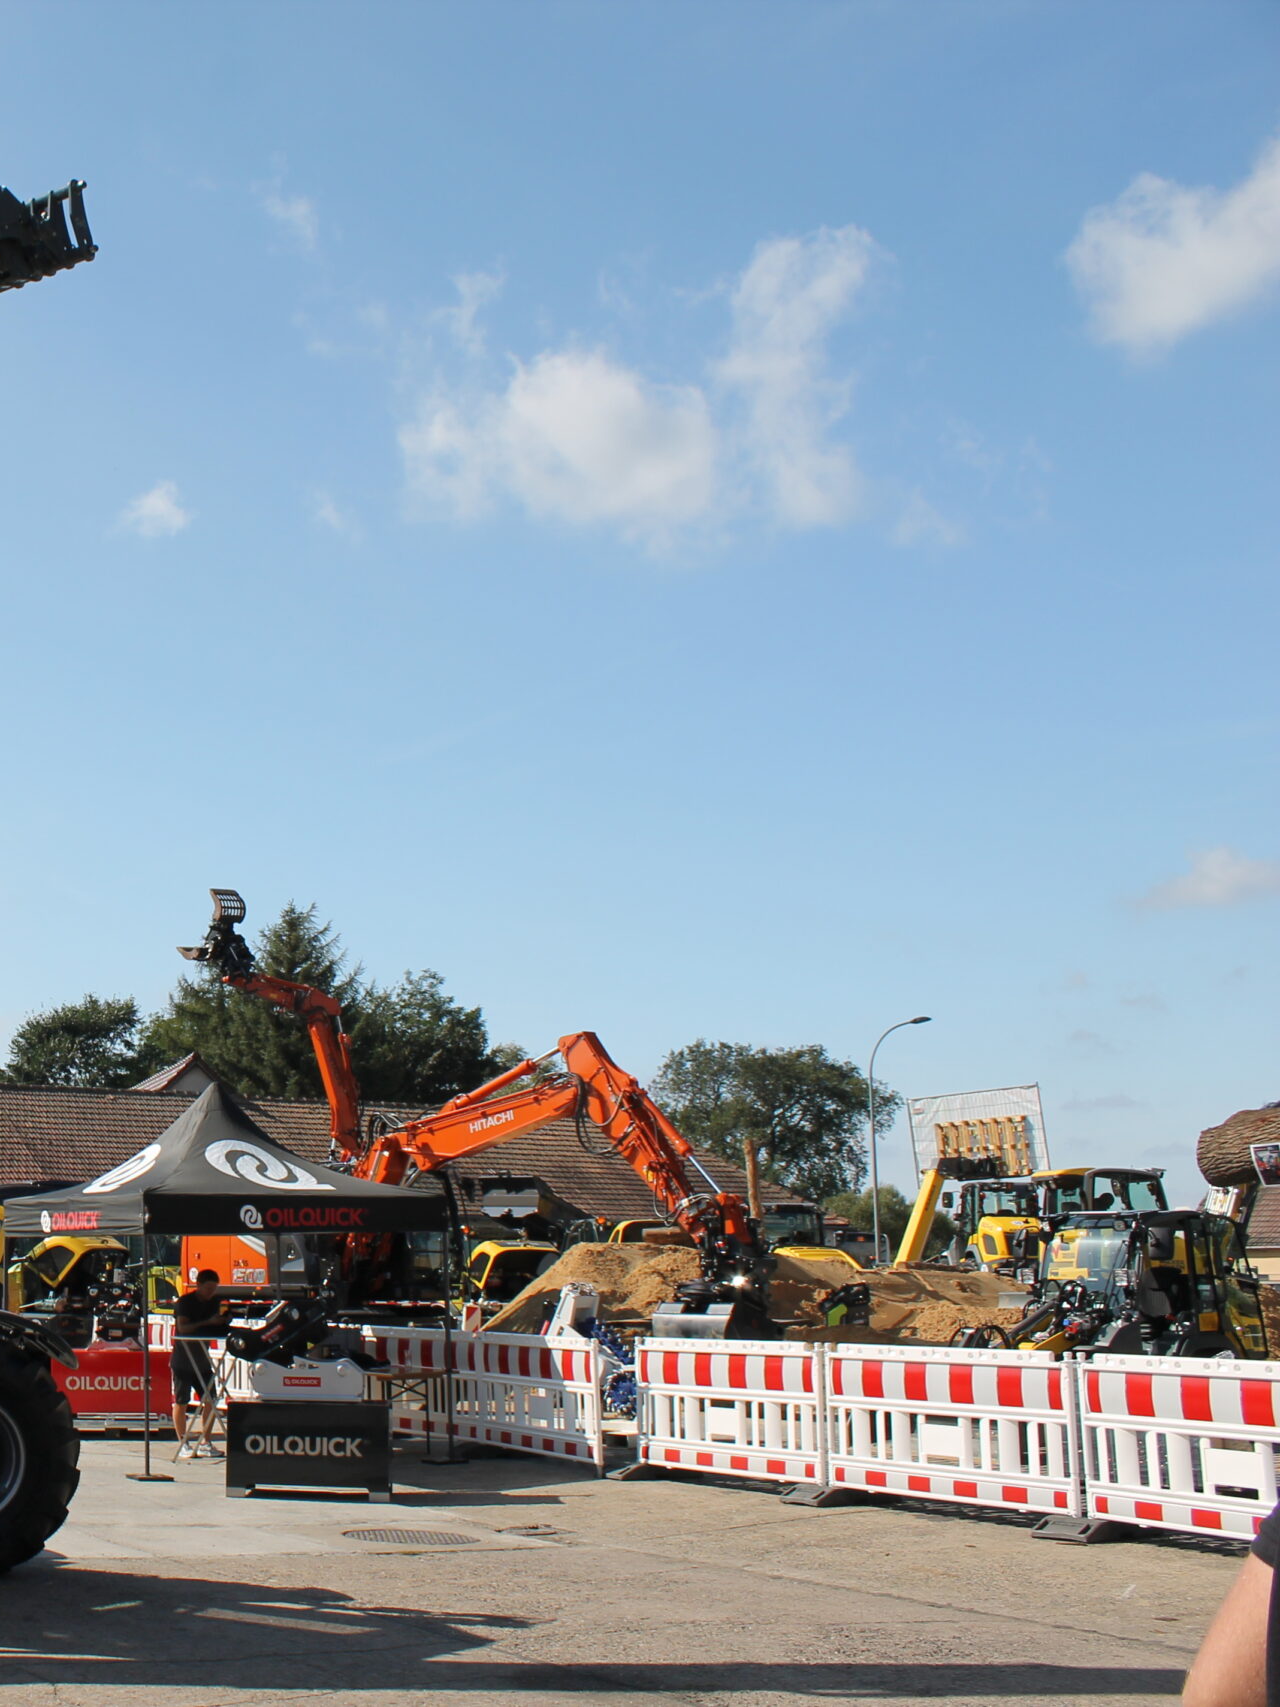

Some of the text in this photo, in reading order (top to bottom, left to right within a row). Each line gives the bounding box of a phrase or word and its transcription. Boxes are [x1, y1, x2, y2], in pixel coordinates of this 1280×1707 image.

[469, 1109, 515, 1134] HITACHI
[52, 1211, 99, 1230] OILQUICK
[265, 1207, 364, 1227] OILQUICK
[245, 1434, 363, 1457] OILQUICK
